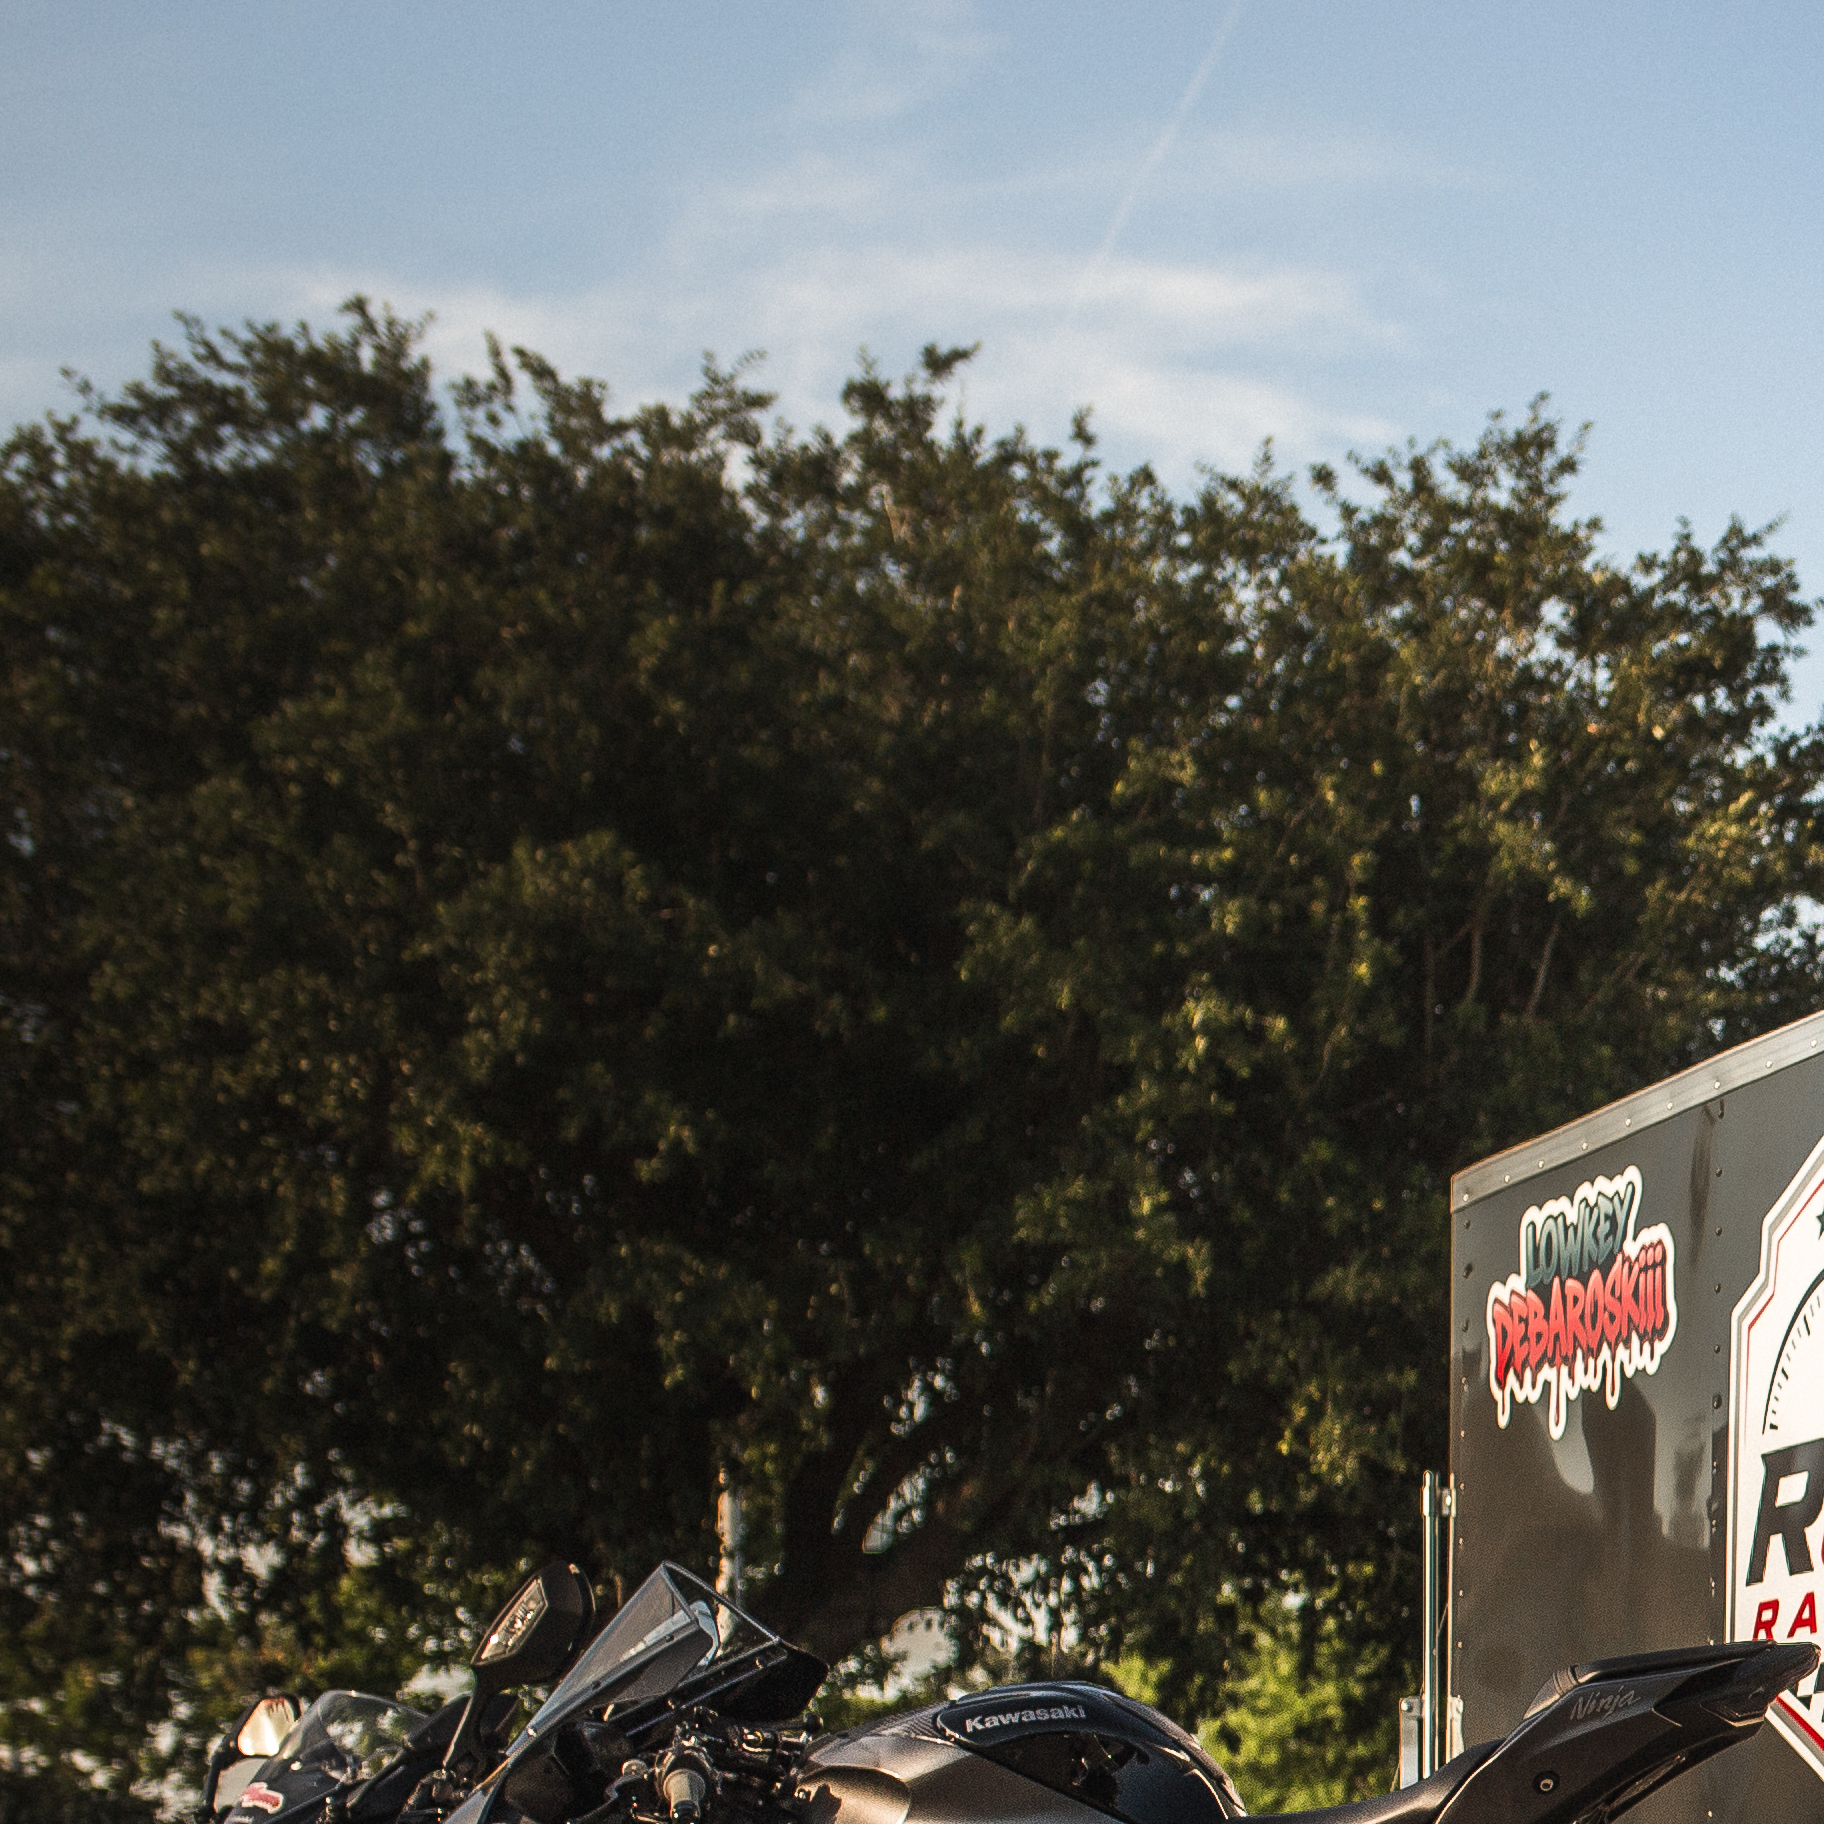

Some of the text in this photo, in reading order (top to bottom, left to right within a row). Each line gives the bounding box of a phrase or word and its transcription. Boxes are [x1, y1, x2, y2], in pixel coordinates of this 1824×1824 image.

[1524, 1180, 1636, 1288] LOWKEY
[965, 1704, 1087, 1733] Kawasaki
[1569, 1685, 1642, 1721] Ninja
